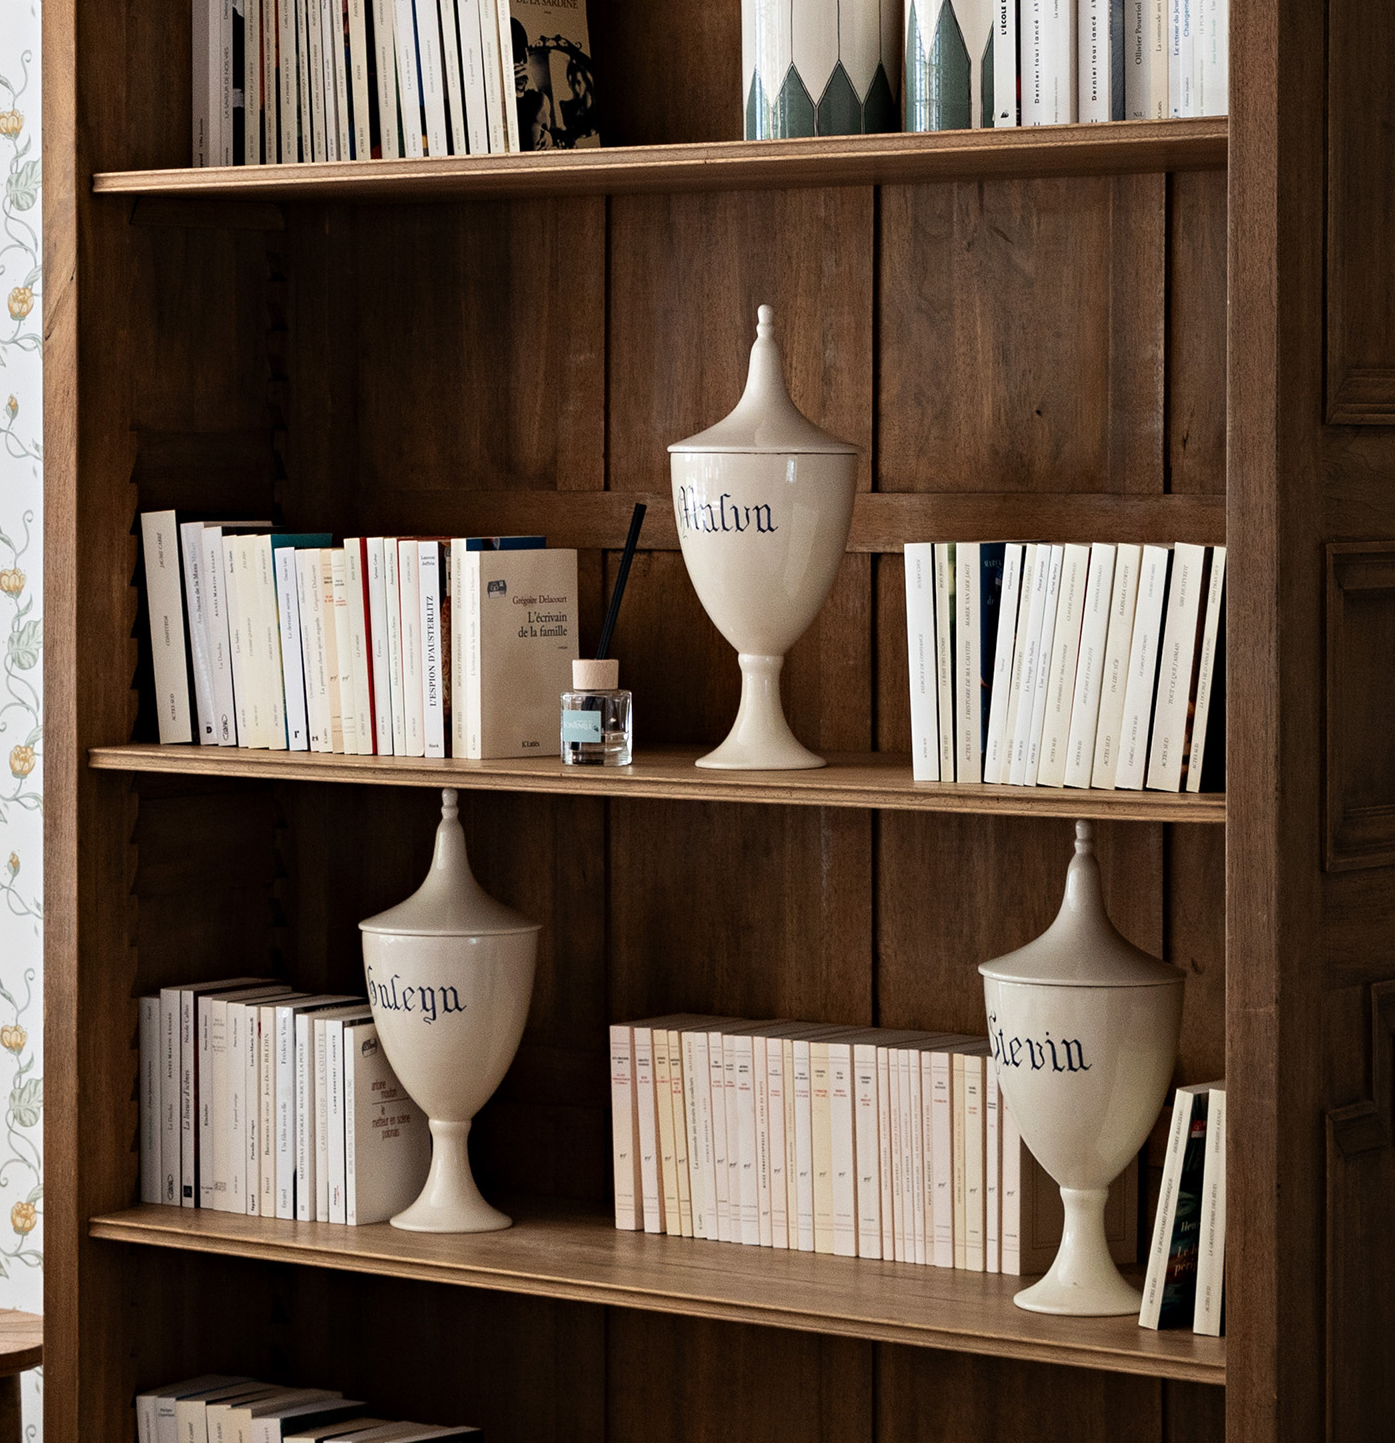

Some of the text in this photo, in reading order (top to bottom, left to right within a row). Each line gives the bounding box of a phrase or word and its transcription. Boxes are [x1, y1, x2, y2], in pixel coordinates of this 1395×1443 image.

[999, 6, 1007, 35] L'ÉCOLE
[1134, 2, 1143, 34] Pourriol
[1173, 15, 1179, 25] du
[1134, 36, 1143, 65] Ollivier
[1156, 44, 1162, 52] La
[1173, 46, 1179, 56] Le
[512, 595, 568, 607] Grégoire Delacourt
[527, 611, 568, 624] L'écrivain
[518, 624, 568, 638] de la famille
[425, 595, 437, 707] L'ESPION D'AUSTERLITZ
[965, 667, 971, 677] MA
[965, 677, 971, 686] DE
[1161, 751, 1169, 769] ACTES
[183, 1121, 190, 1130] La
[281, 1143, 287, 1152] Un
